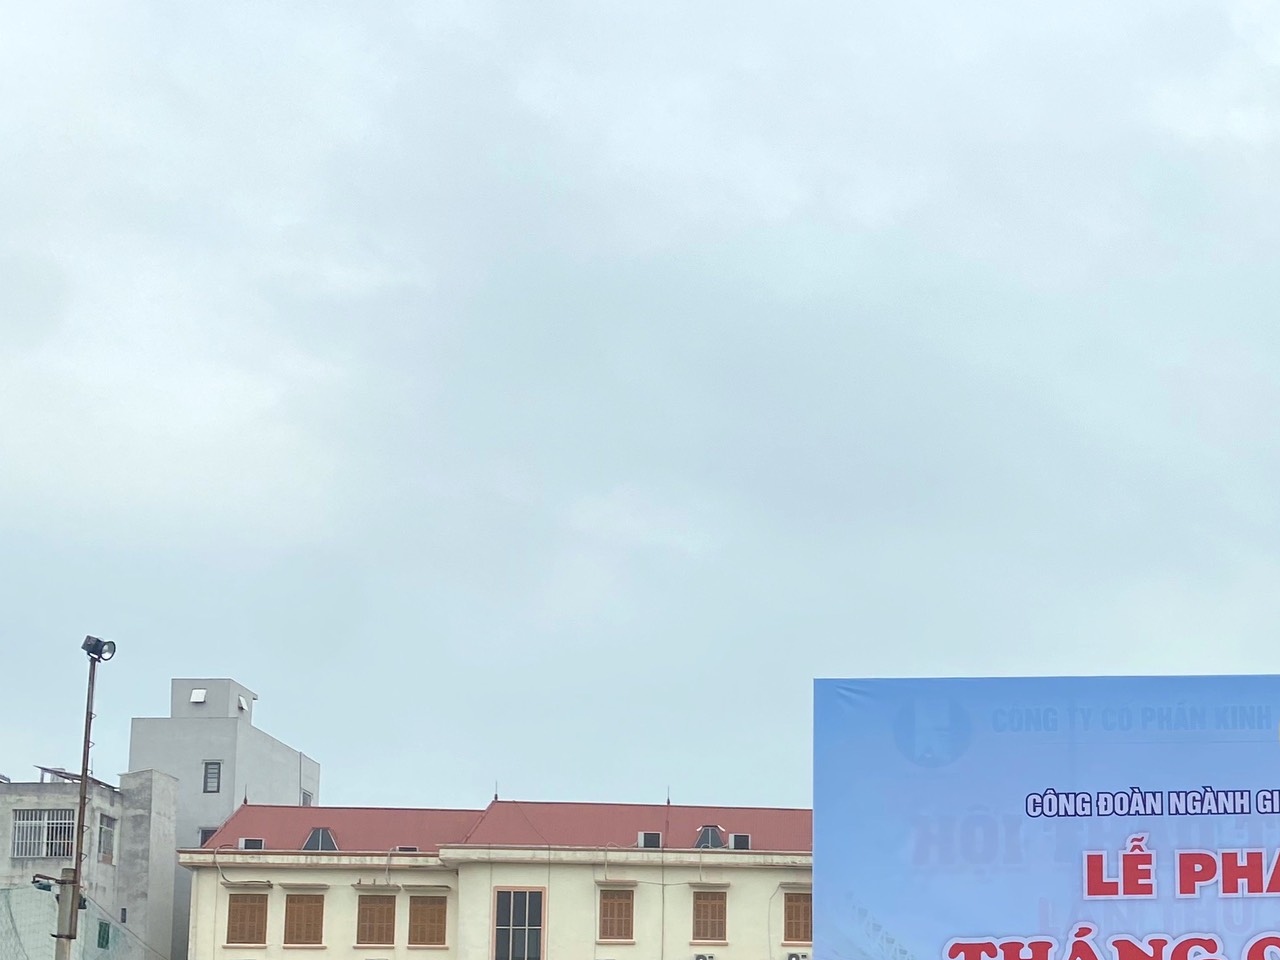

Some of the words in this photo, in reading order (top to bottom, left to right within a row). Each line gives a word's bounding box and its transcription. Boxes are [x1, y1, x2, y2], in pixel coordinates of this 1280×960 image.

[1026, 788, 1092, 817] CÔNG
[1096, 786, 1163, 816] ĐOÀN
[1168, 785, 1251, 815] NGÀNH
[1087, 835, 1154, 896] LỄ
